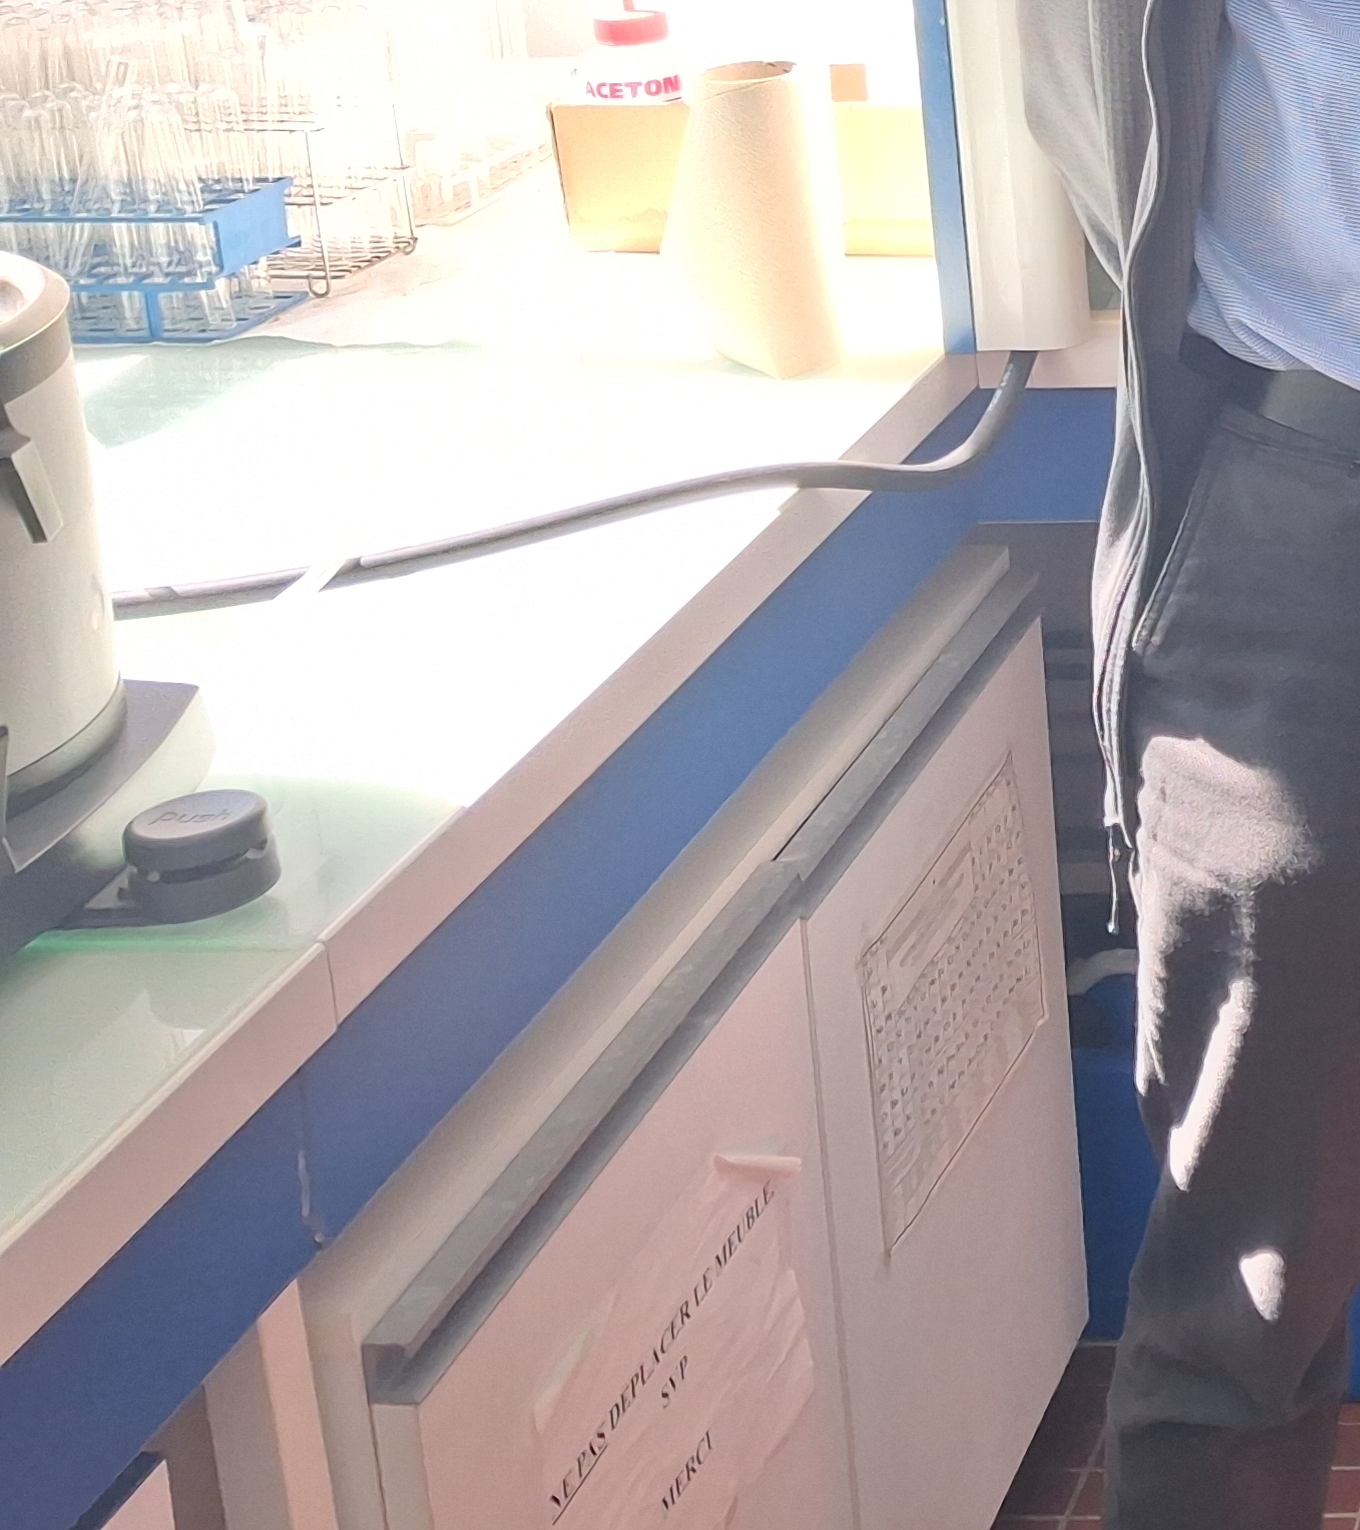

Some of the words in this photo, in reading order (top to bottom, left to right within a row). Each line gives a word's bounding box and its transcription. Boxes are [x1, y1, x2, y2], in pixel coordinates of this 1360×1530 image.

[586, 74, 682, 100] ACETON
[549, 1469, 574, 1509] NE
[575, 1421, 607, 1479] PAS
[608, 1300, 692, 1431] DEPLACER
[692, 1266, 714, 1308] LE
[714, 1179, 776, 1271] MEUBLE
[660, 1354, 689, 1409] SVP
[661, 1429, 714, 1512] MERCI
